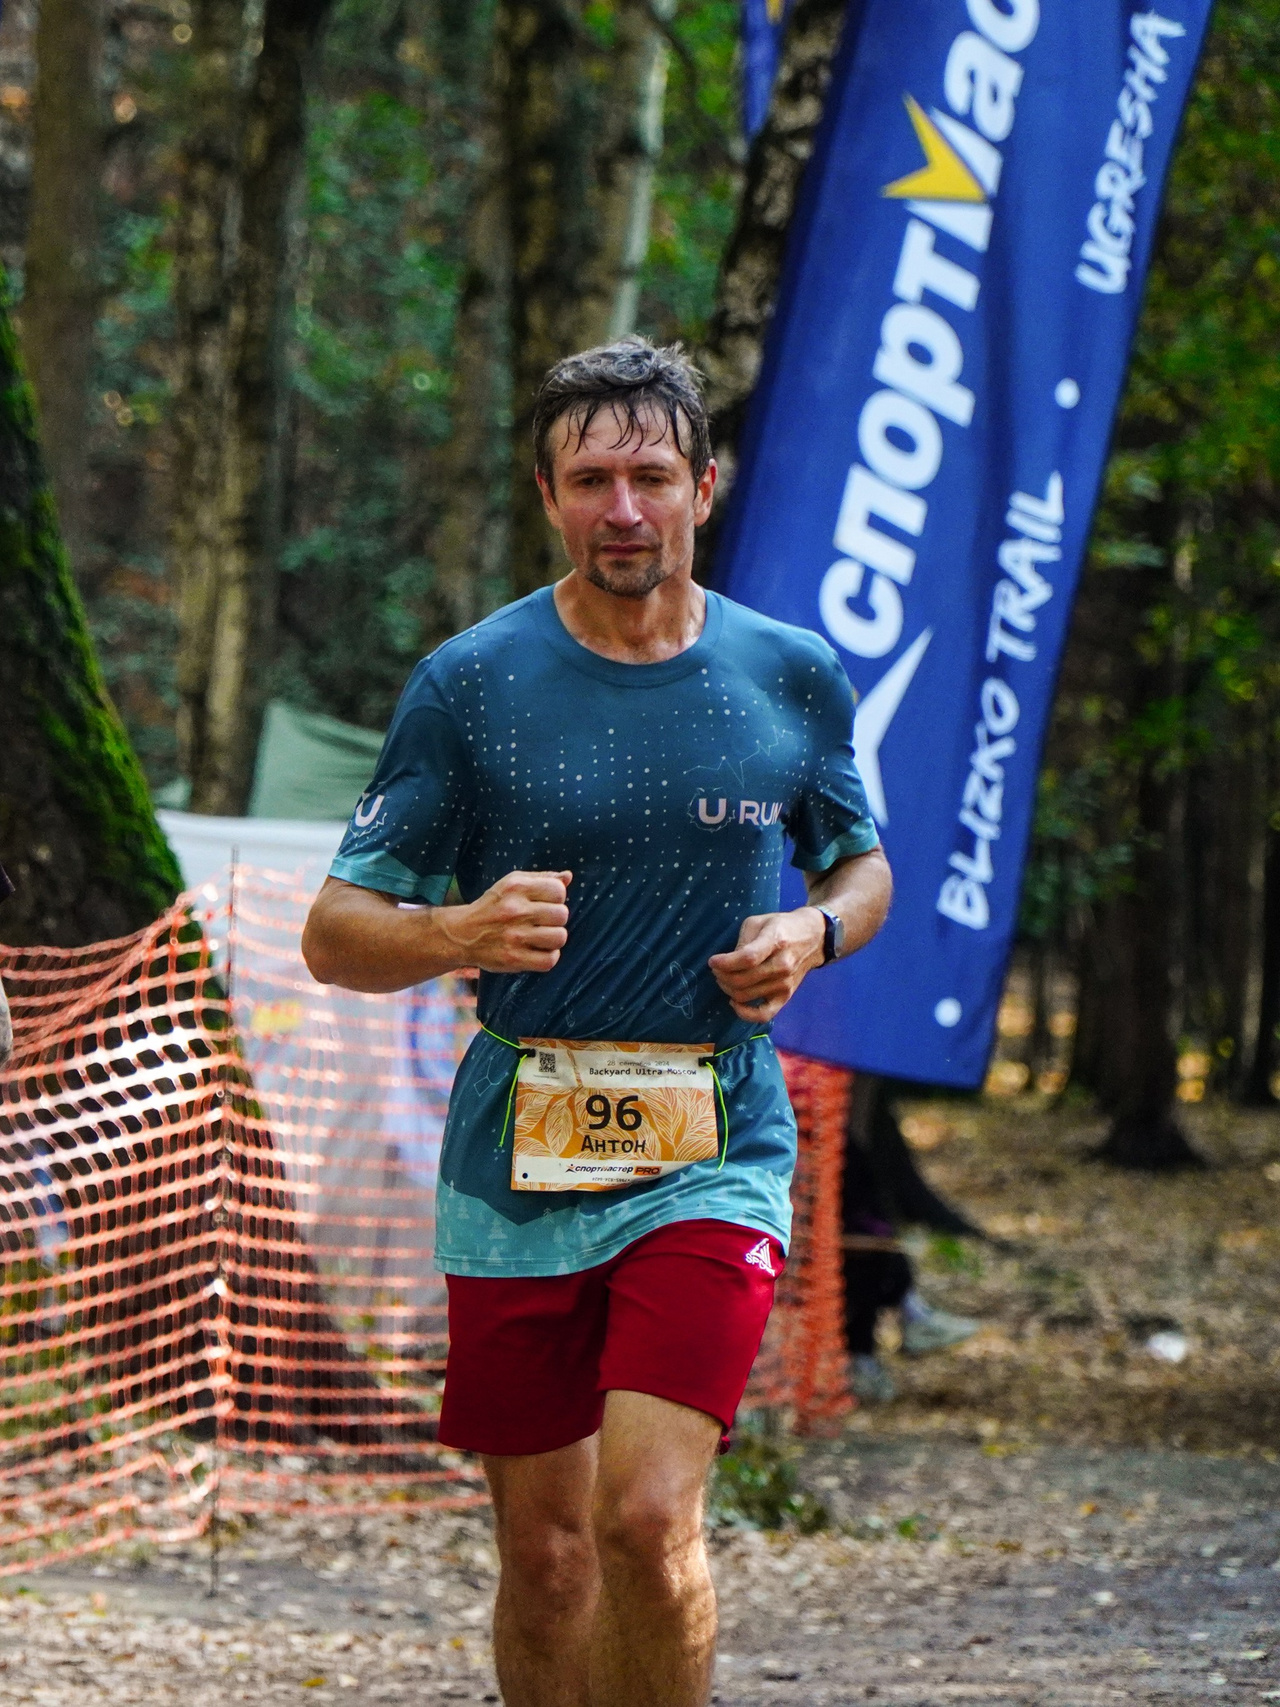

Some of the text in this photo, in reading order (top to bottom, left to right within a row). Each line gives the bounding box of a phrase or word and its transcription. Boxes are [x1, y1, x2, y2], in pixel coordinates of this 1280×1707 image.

[1074, 8, 1187, 294] UGRESHA
[936, 470, 1065, 931] BLIZKO TRAIL
[698, 798, 727, 824] U
[589, 1067, 697, 1078] Backyard Ultra Moscow
[585, 1094, 643, 1131] 96
[581, 1134, 647, 1154] Антон
[634, 1166, 661, 1175] PRO
